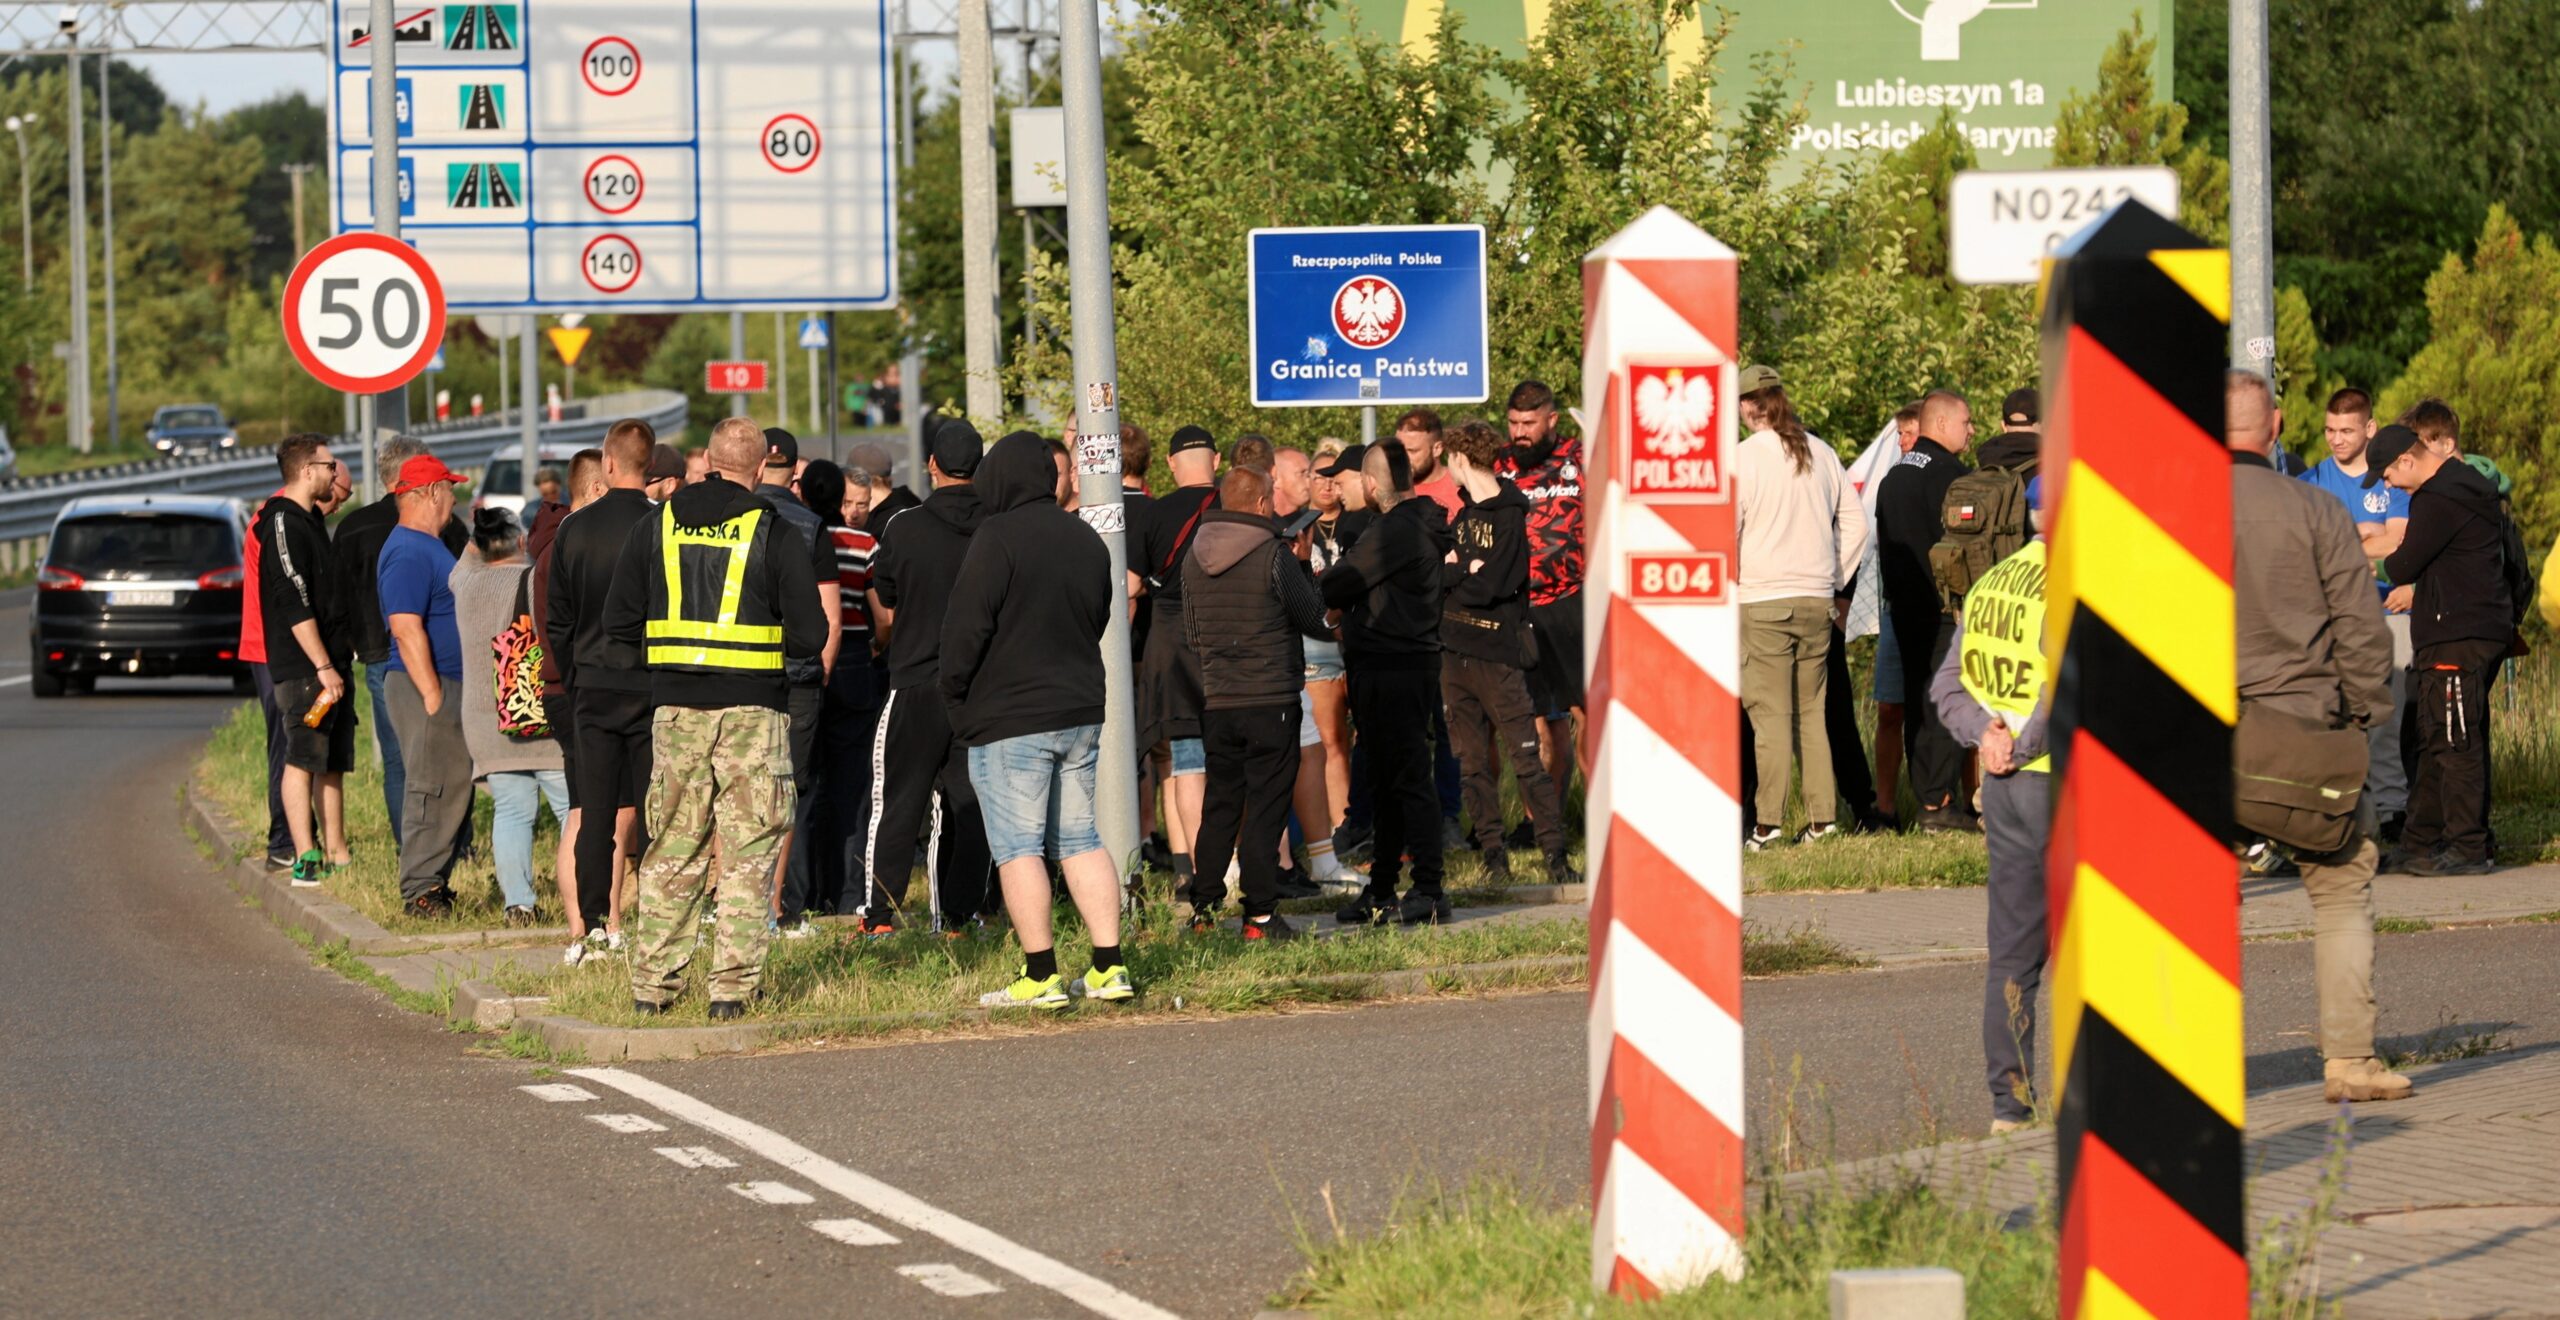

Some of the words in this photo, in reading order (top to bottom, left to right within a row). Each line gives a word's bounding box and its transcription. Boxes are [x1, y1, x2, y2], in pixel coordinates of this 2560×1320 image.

[589, 55, 634, 78] 100
[1836, 77, 2002, 114] Lubieszyn
[2008, 78, 2045, 106] 1a
[770, 129, 812, 158] 80
[591, 174, 637, 197] 120
[589, 252, 634, 275] 140
[1292, 252, 1393, 270] Rzeczpospolita
[1398, 252, 1442, 266] Polska
[318, 277, 421, 350] 50
[724, 366, 751, 388] 10
[1270, 359, 1362, 380] Granica
[1375, 357, 1469, 378] Państwa
[1632, 458, 1717, 490] POLSKA
[672, 522, 740, 541] POLSKA
[1641, 562, 1714, 594] 804
[1972, 558, 2048, 602] HRONA
